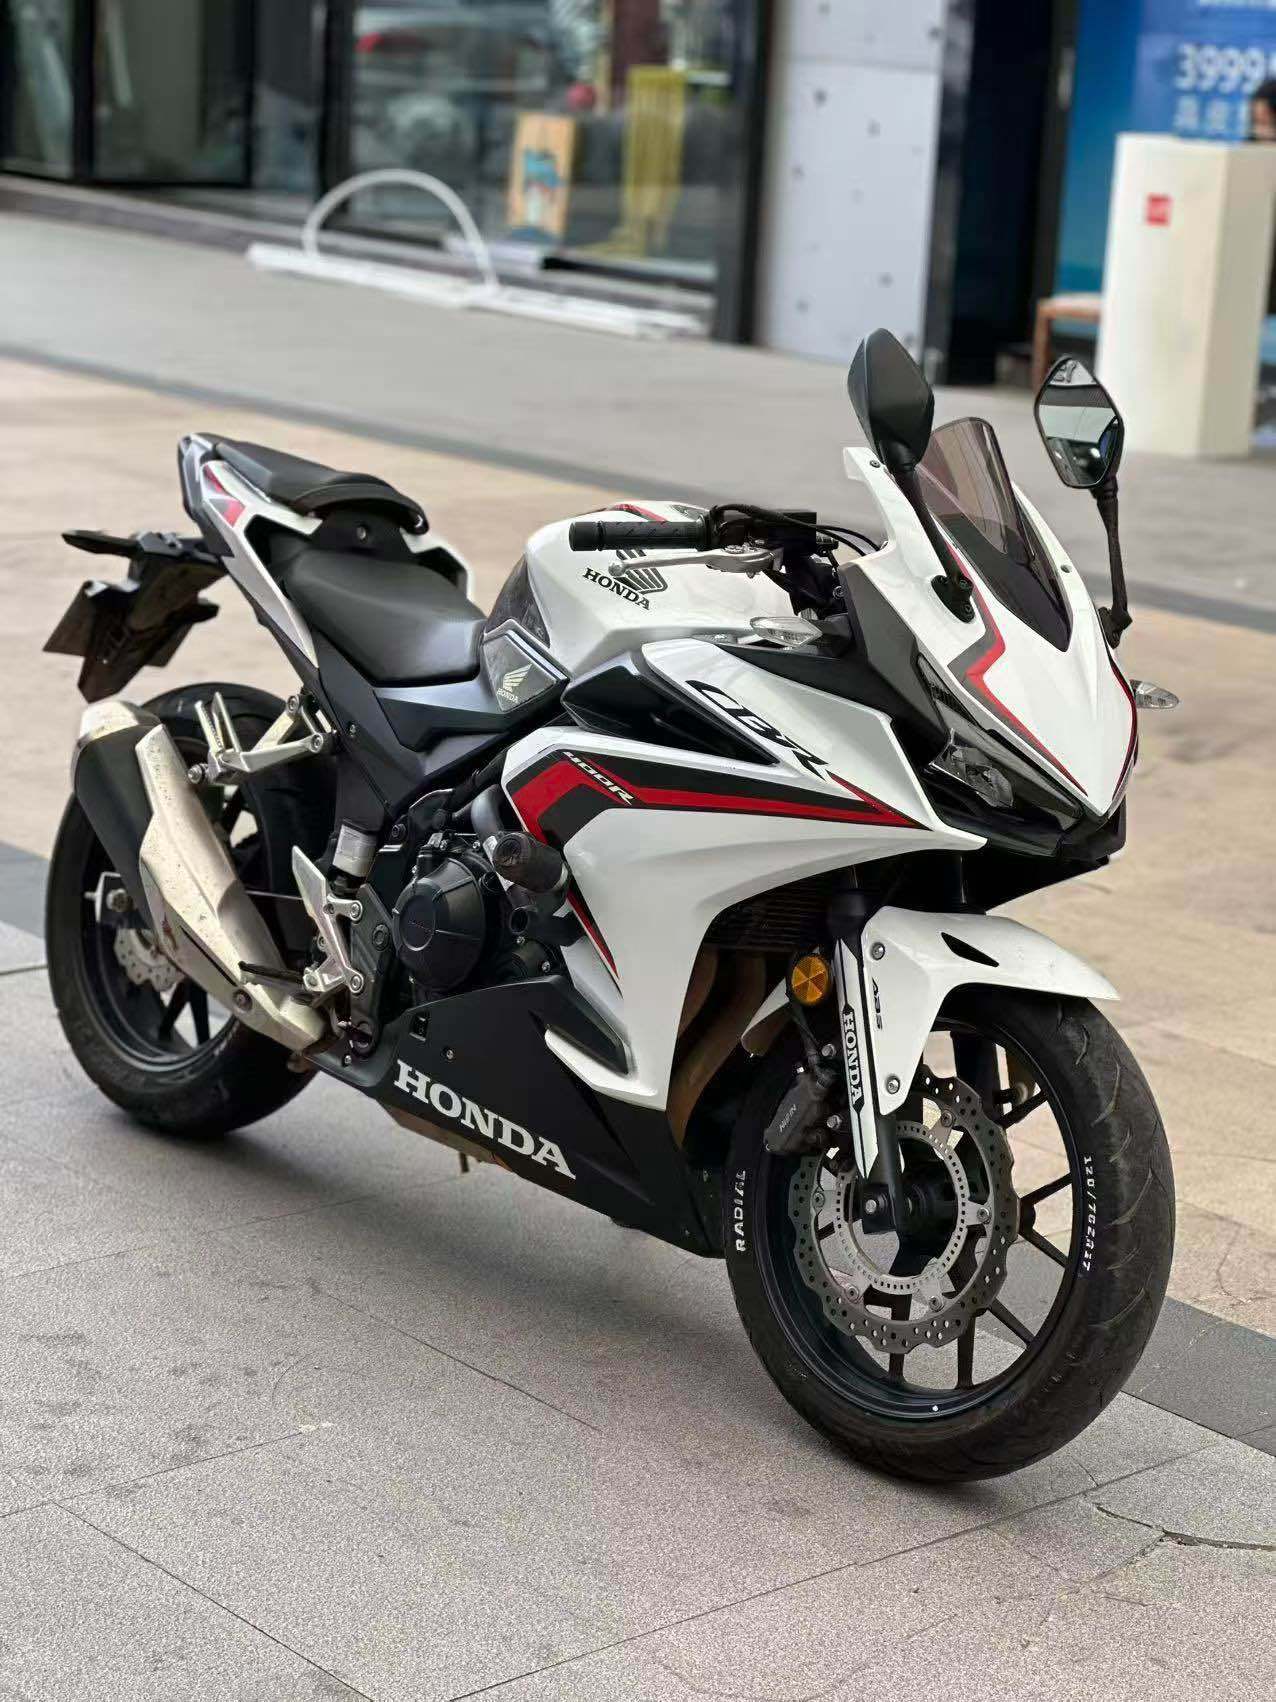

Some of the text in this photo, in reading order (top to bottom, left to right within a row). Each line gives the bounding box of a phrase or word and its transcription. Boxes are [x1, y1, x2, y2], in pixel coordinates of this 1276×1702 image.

[582, 567, 651, 611] HONDA
[496, 687, 519, 704] HONDA
[685, 680, 829, 782] CBR
[562, 751, 636, 806] 400R
[871, 976, 884, 1031] ABS
[843, 1010, 864, 1105] HONDA
[393, 1059, 577, 1180] HONDA
[734, 1170, 746, 1252] RADIAL
